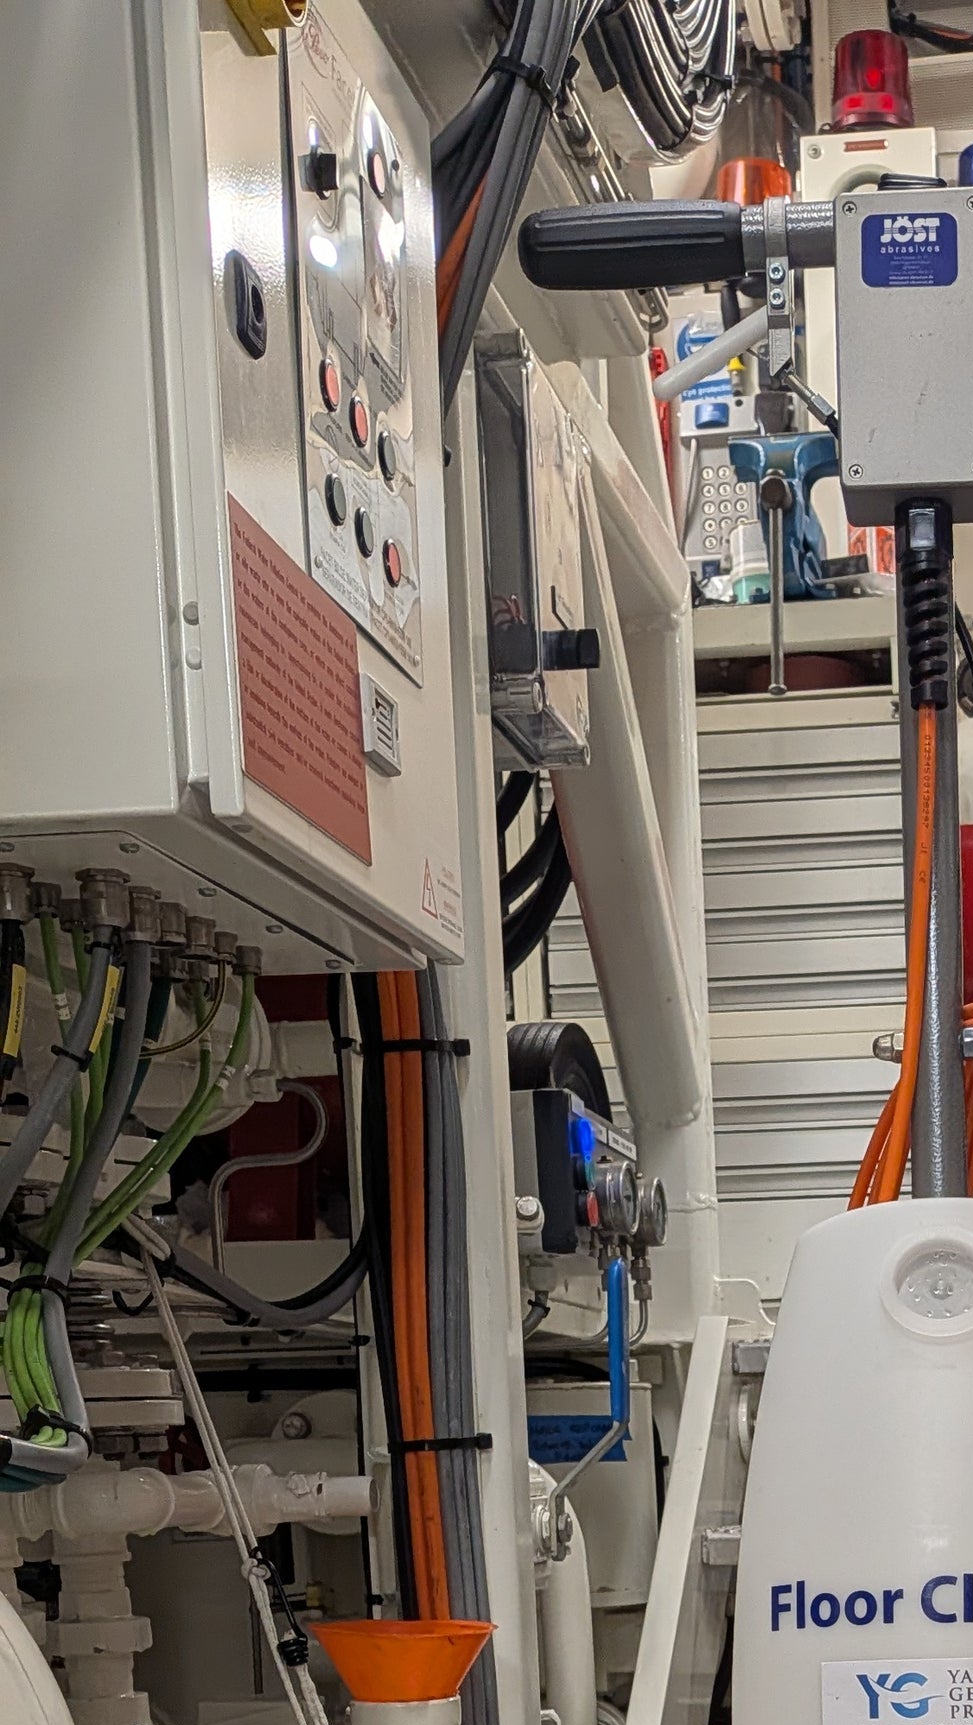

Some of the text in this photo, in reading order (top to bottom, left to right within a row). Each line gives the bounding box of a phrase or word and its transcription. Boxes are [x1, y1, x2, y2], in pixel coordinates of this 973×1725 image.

[880, 215, 941, 243] JÖST
[880, 245, 940, 254] abrasives
[771, 1580, 904, 1632] Floor
